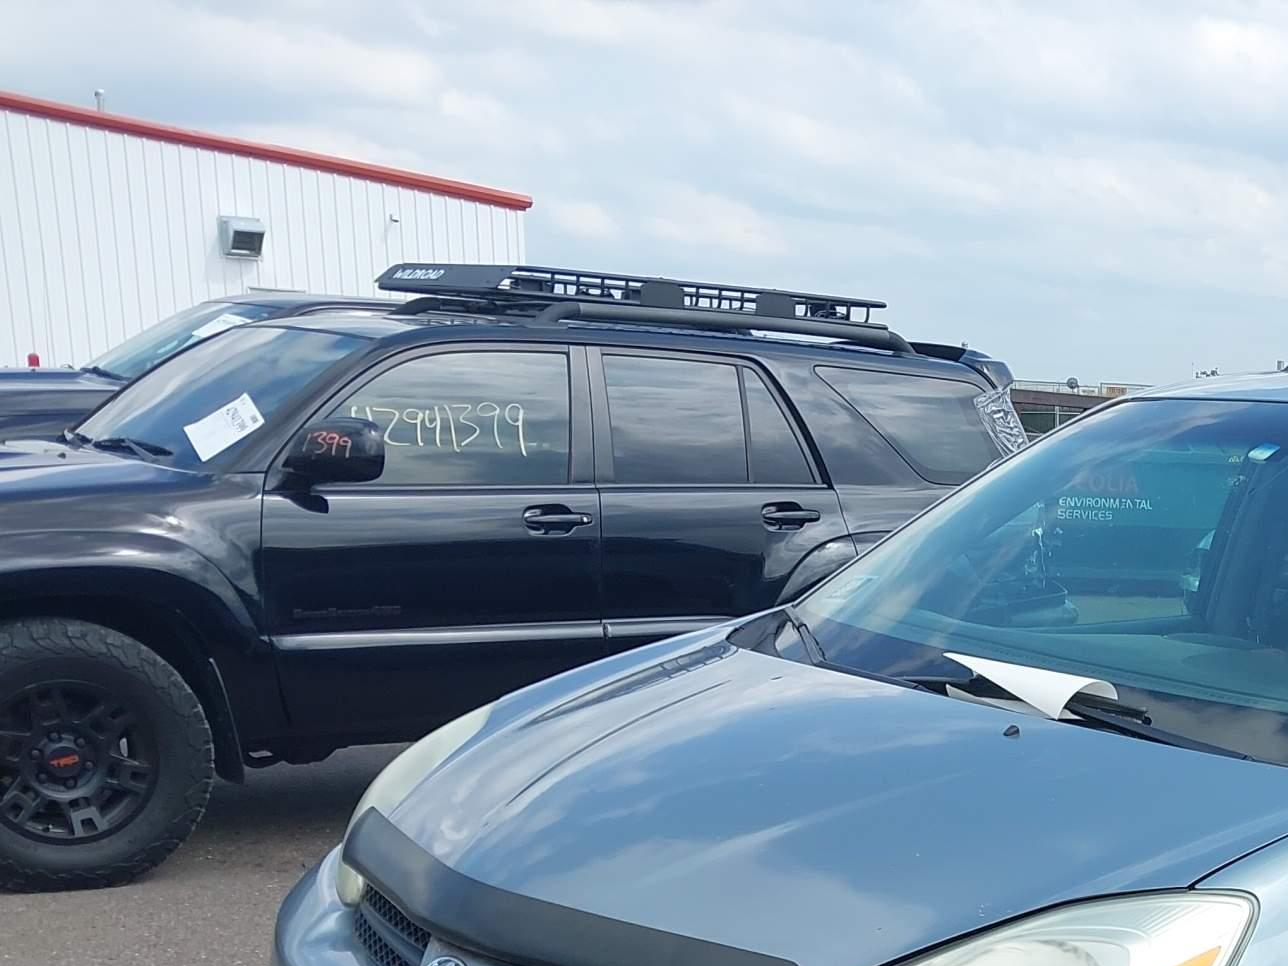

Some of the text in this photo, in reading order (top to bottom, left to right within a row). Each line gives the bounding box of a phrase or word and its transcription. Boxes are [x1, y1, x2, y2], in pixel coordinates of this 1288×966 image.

[302, 431, 353, 459] 1399
[1058, 496, 1152, 511] ENVIRONMENTAL
[1056, 509, 1113, 521] SERVICES
